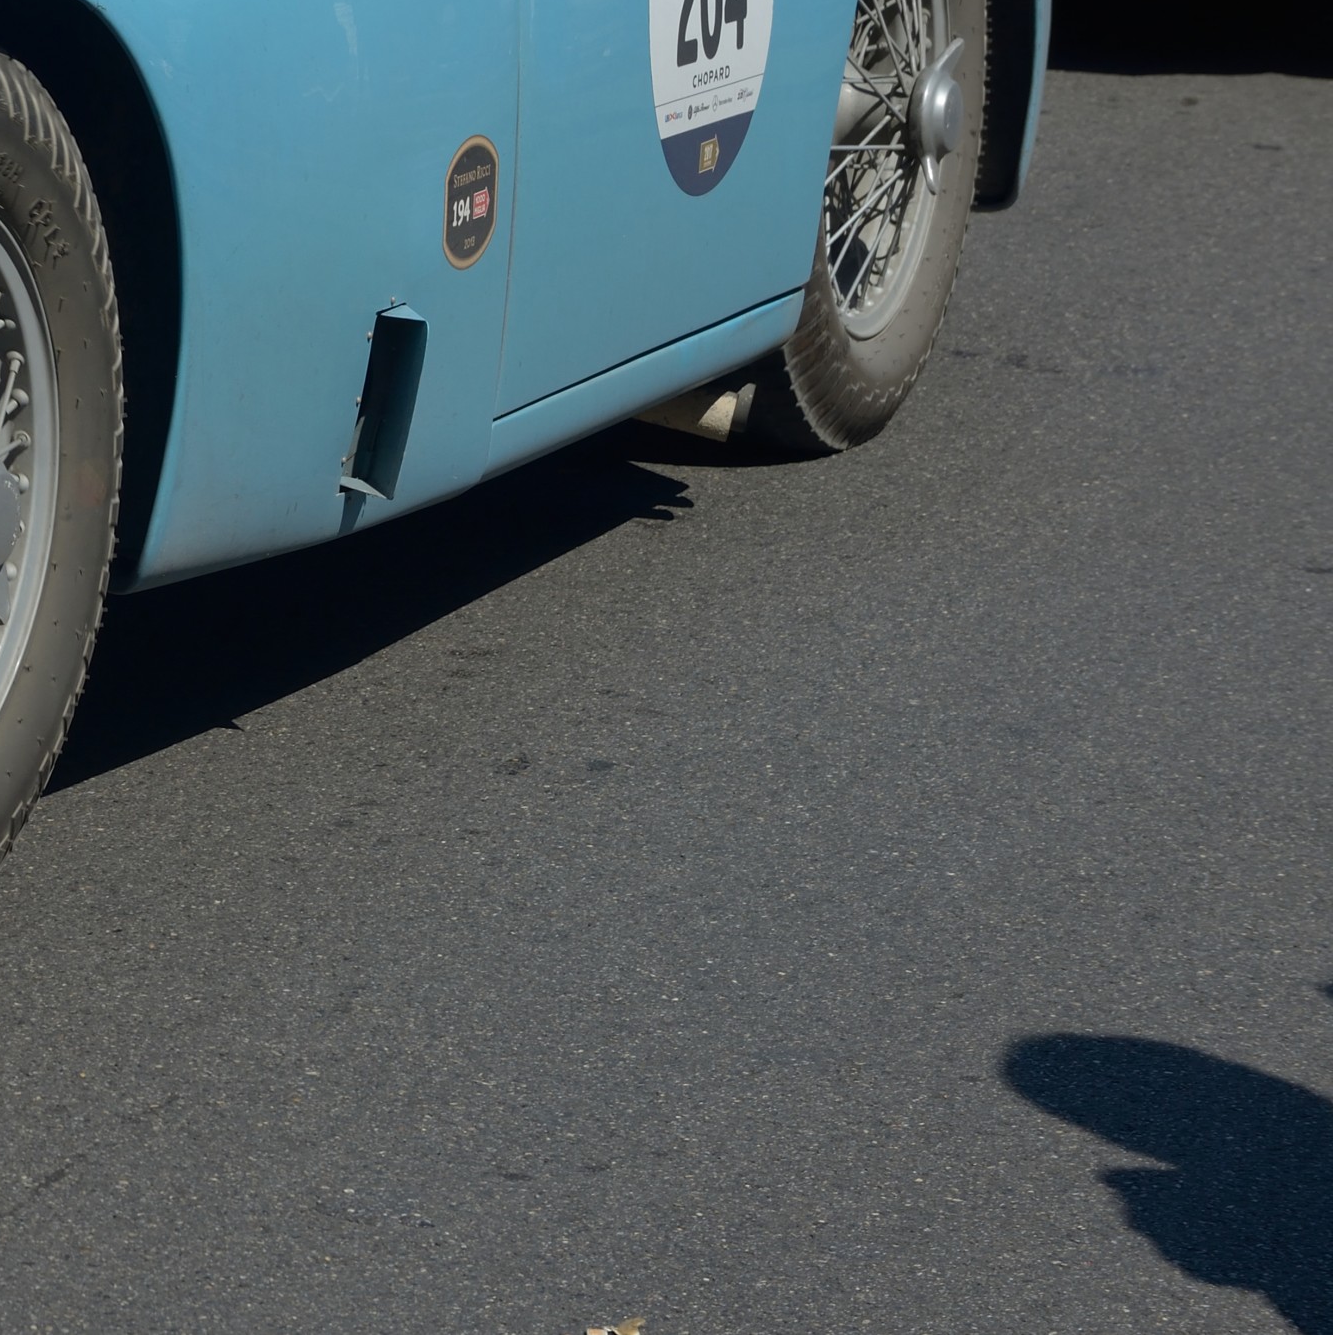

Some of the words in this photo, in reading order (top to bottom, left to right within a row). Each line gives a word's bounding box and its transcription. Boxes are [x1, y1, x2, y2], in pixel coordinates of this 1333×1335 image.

[692, 65, 731, 88] CHOPARD
[477, 164, 492, 180] RICCI
[452, 196, 470, 227] 194
